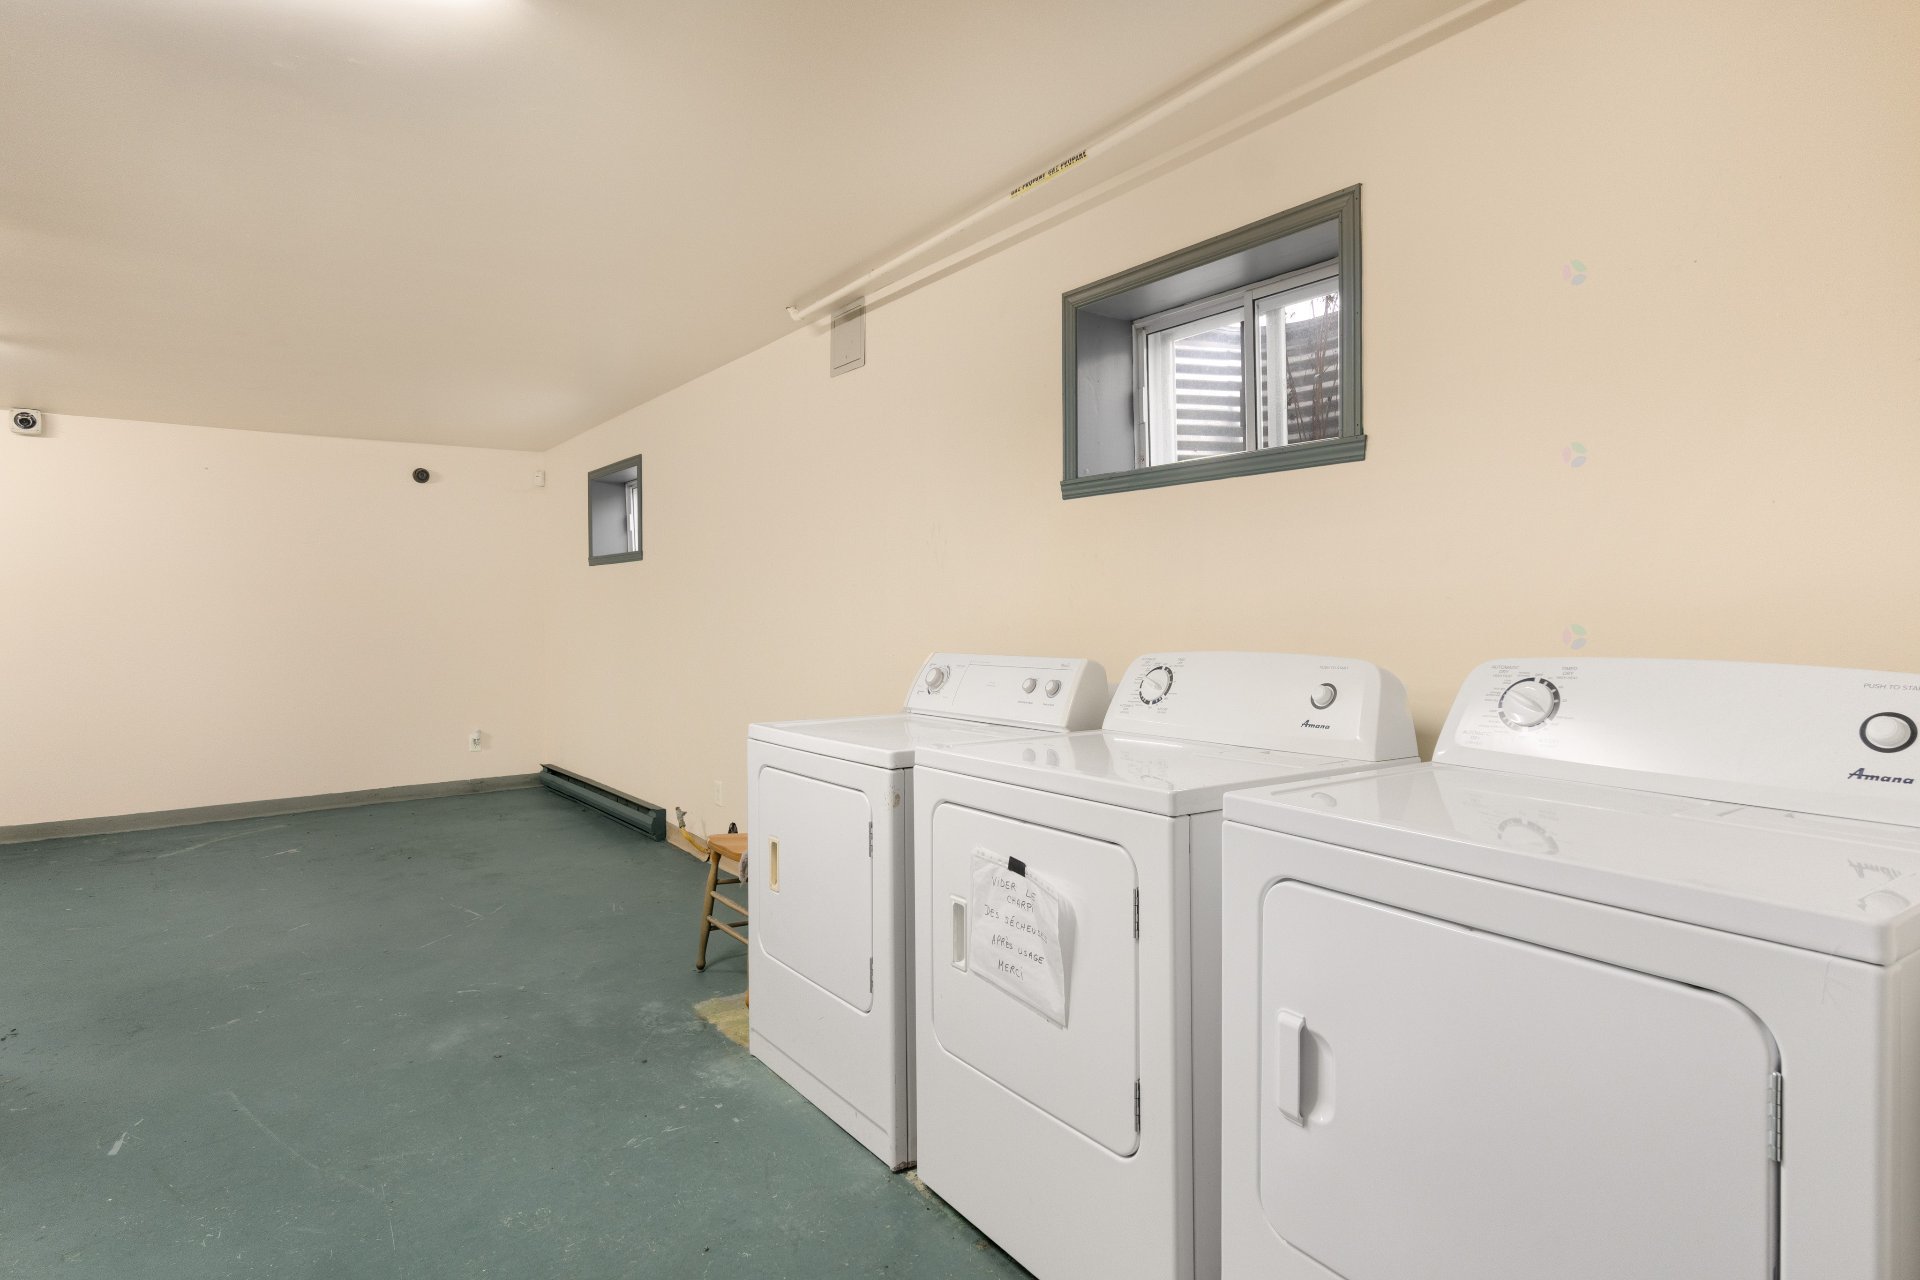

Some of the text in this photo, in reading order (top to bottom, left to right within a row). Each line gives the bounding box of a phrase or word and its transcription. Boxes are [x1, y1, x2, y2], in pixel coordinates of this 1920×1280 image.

[1301, 719, 1331, 730] Amana
[1847, 767, 1915, 785] Amana
[991, 876, 1016, 892] VIDER
[984, 904, 999, 919] DES
[991, 934, 1045, 965] APRÈS USAGE
